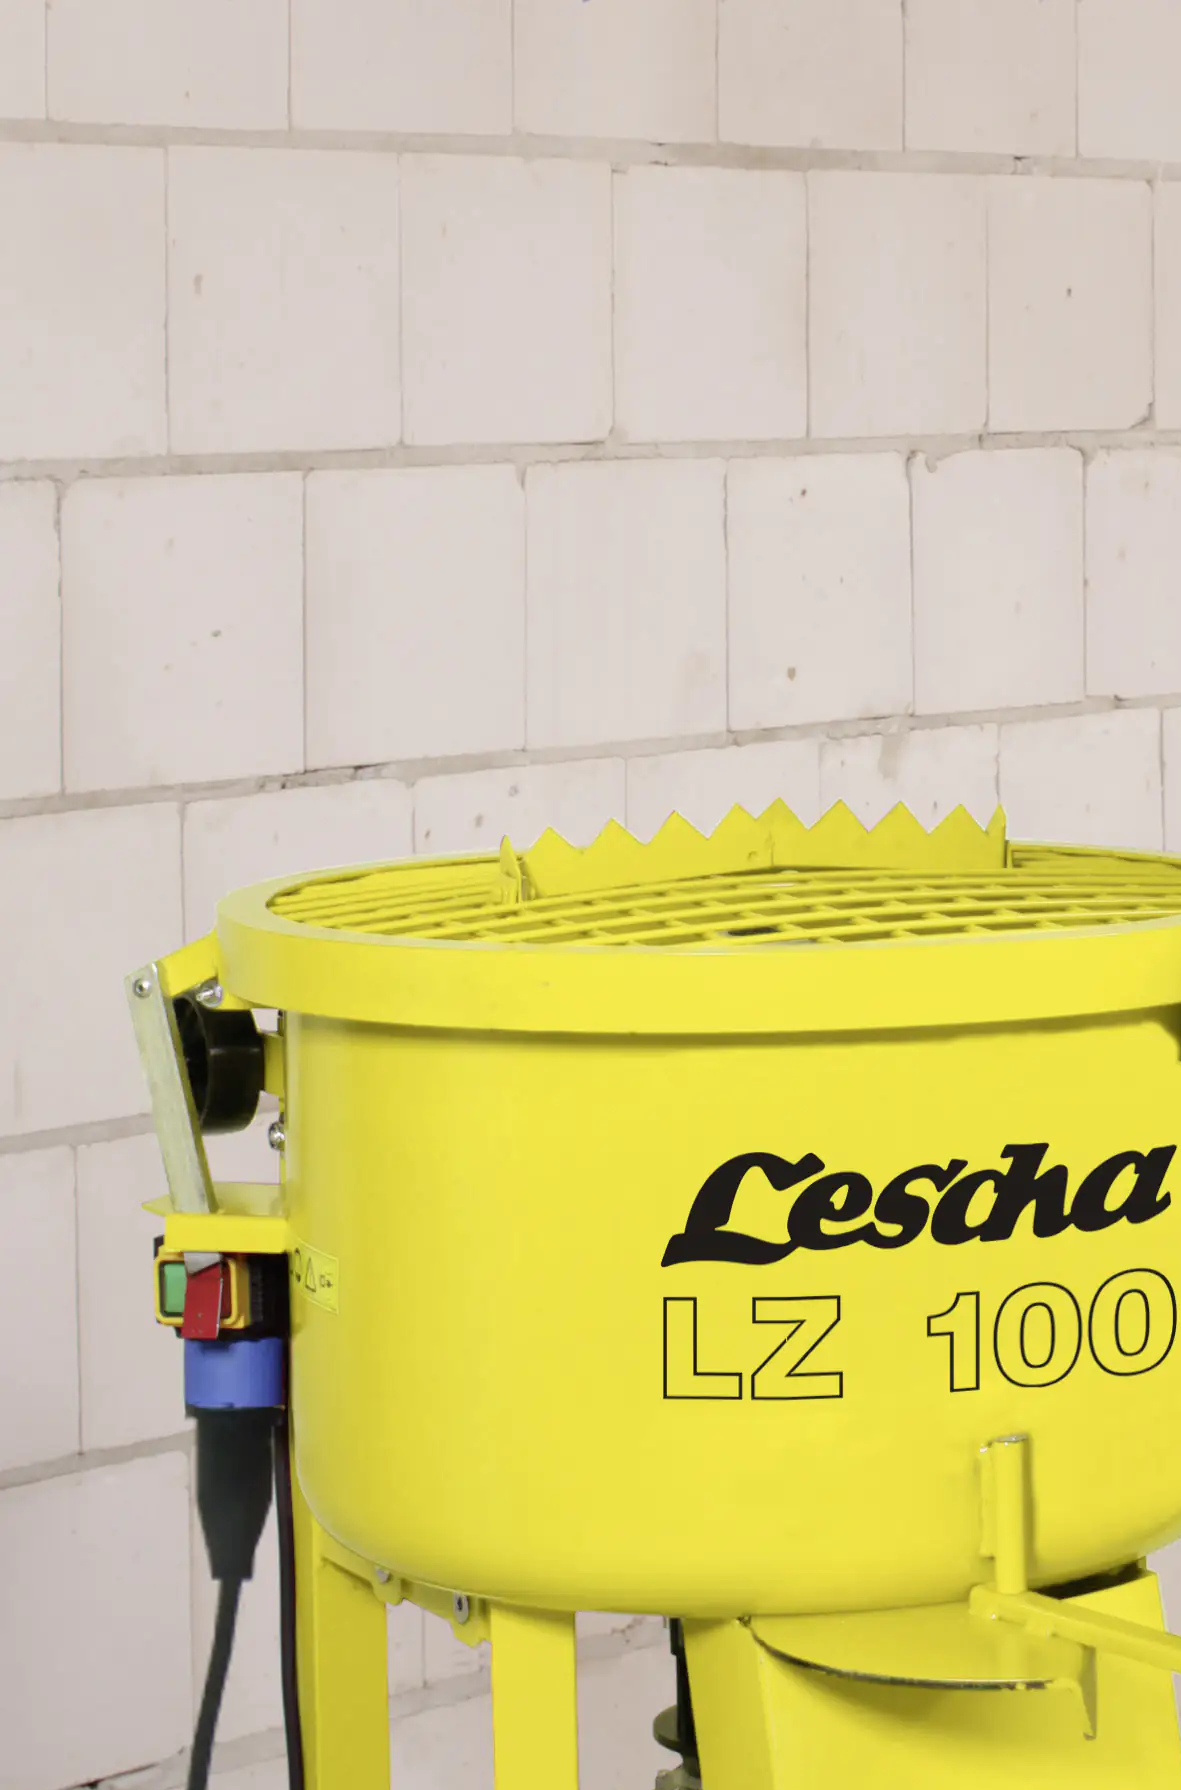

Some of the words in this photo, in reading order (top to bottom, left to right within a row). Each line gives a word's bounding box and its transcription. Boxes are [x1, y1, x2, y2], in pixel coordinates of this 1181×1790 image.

[661, 1143, 1177, 1267] Lescha
[663, 1295, 843, 1400] LZ
[927, 1268, 1177, 1392] 100
